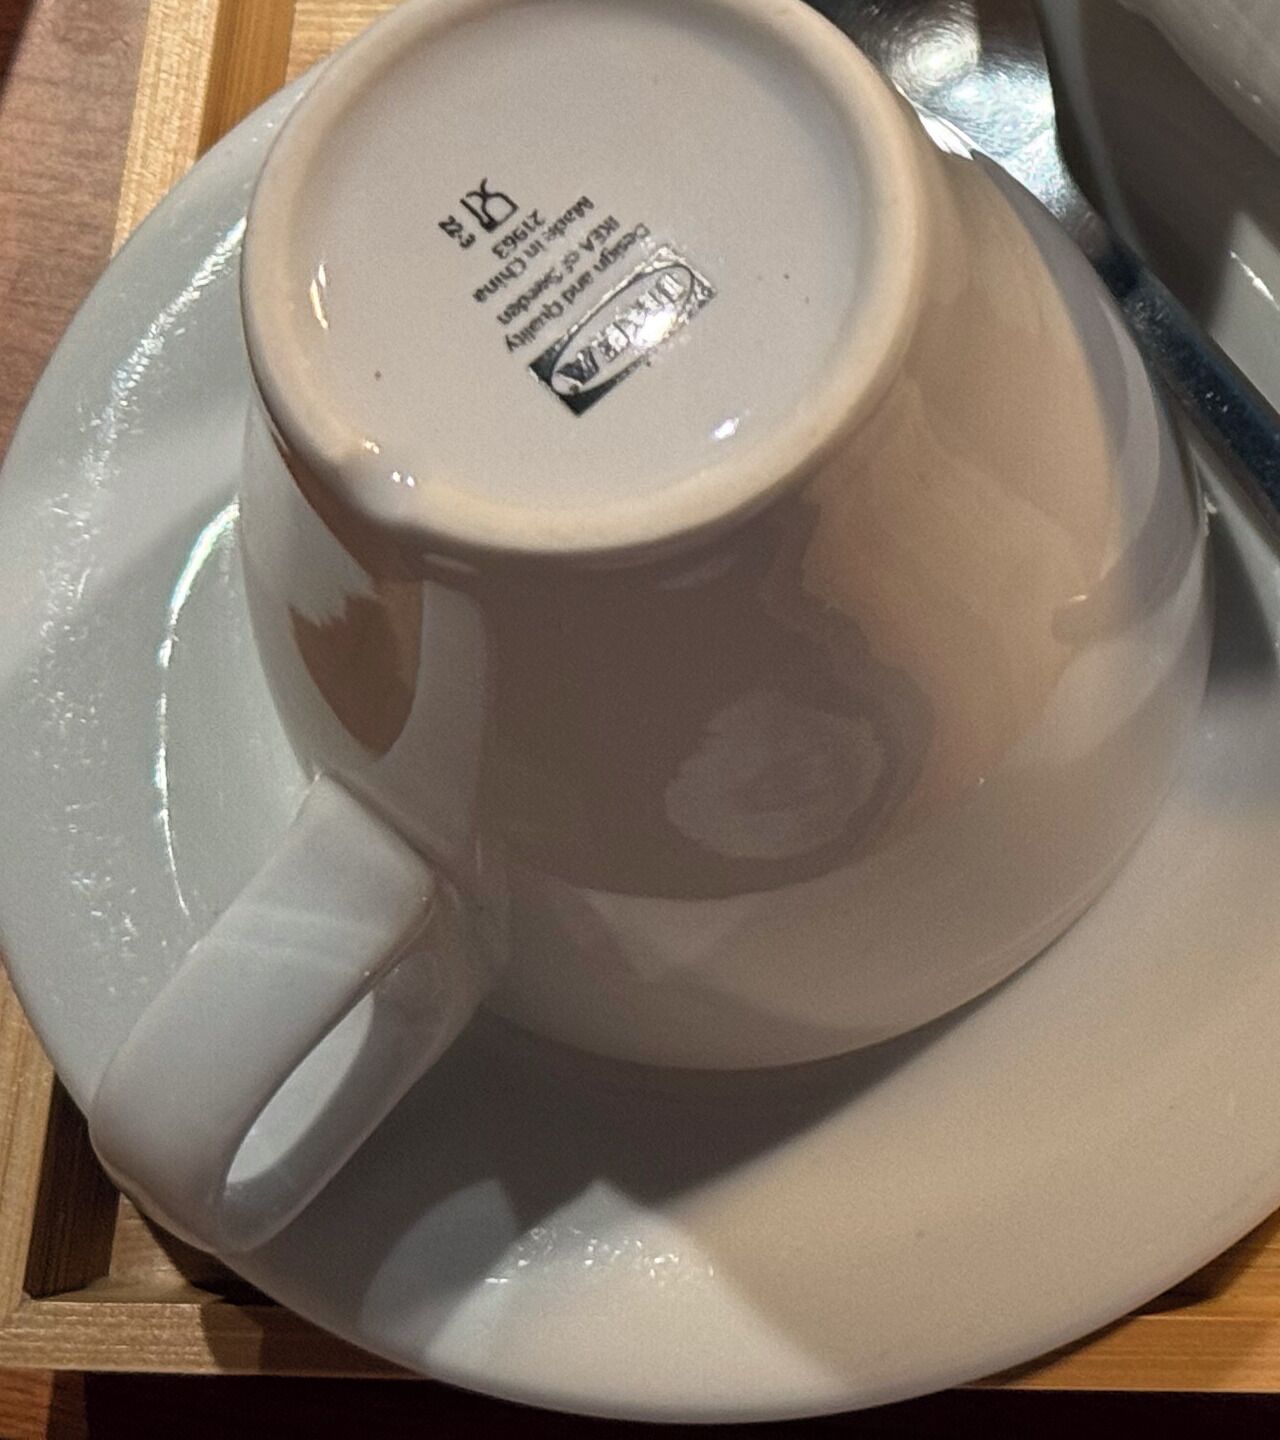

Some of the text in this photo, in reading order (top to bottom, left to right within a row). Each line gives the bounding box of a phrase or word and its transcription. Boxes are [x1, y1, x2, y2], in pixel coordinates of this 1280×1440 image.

[472, 195, 595, 303] Made in China
[491, 209, 546, 259] 21963
[497, 215, 621, 325] IKEA of Sweden
[504, 222, 651, 352] Design and Quality
